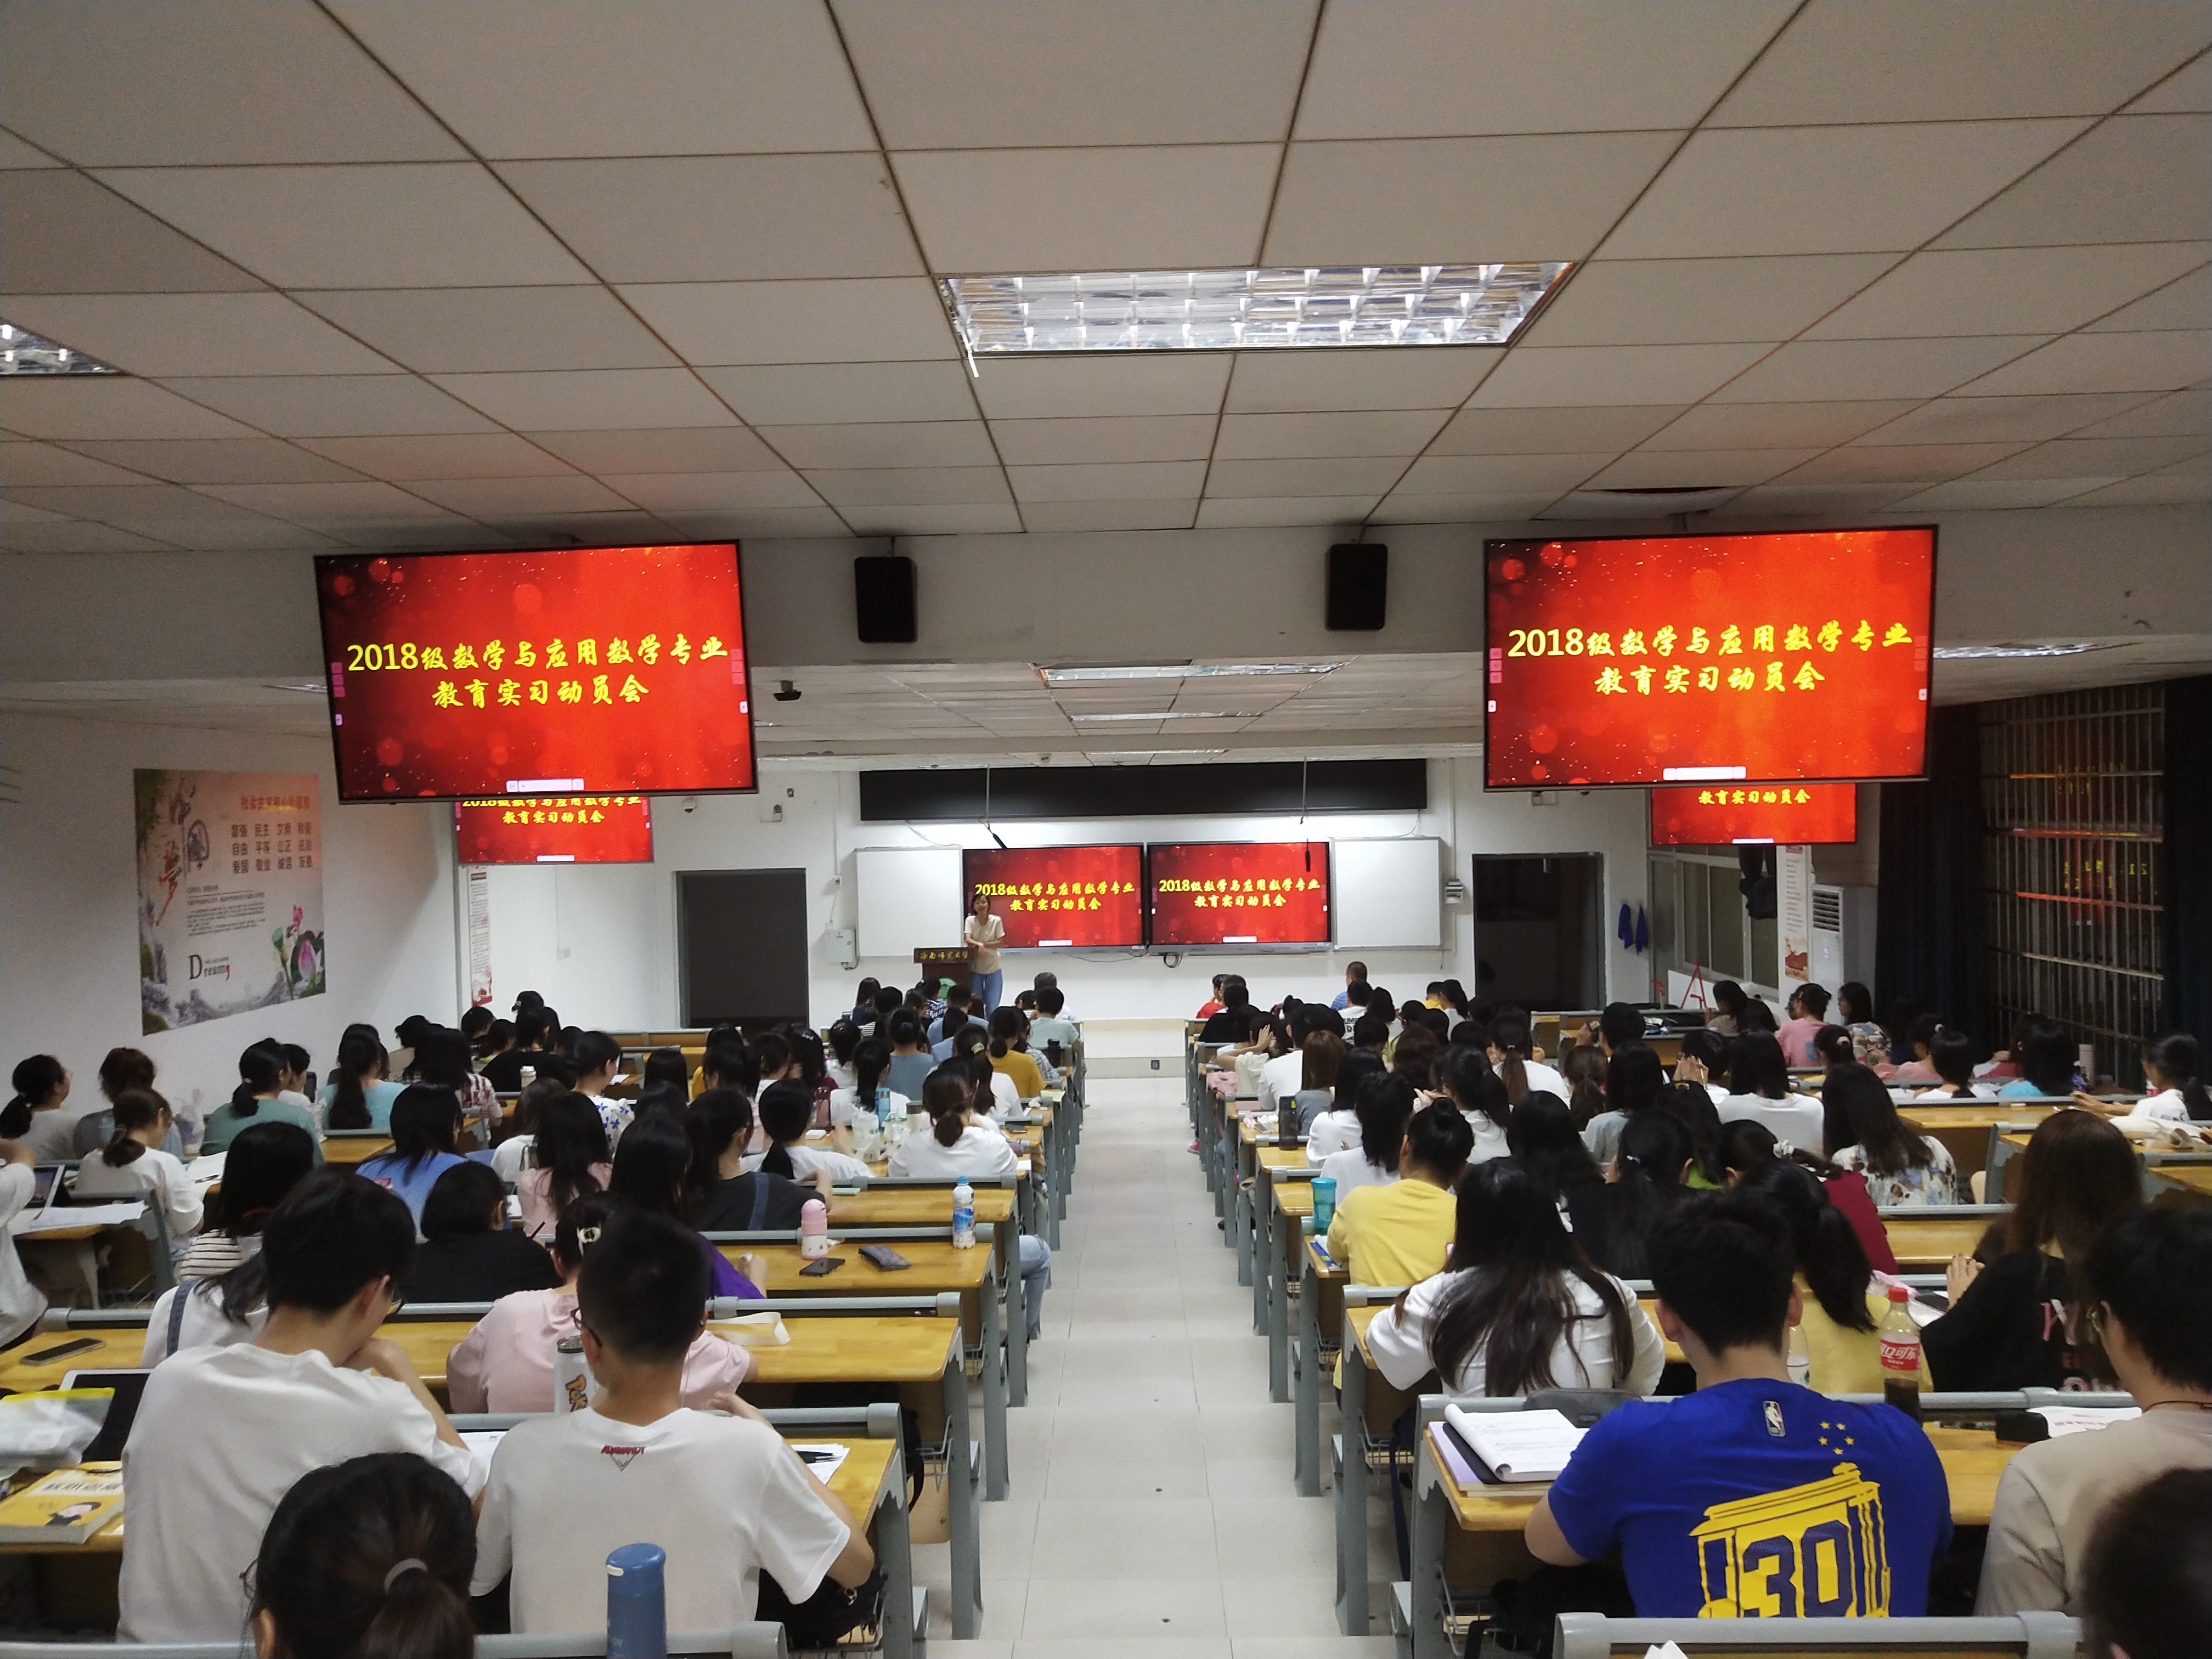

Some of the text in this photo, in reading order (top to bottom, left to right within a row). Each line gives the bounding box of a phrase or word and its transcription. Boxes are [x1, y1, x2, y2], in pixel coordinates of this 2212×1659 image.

[1508, 619, 1913, 657] 2018级数学与应用数学专业
[347, 633, 729, 671] 2018级数学与应用数学专业
[431, 674, 650, 709] 教育实习动员会
[1593, 661, 1826, 696] 教育实习动员会
[1697, 788, 1812, 805] 教育实习动员会
[501, 809, 606, 825] 教育实习动员会
[1158, 877, 1321, 893] 2018级数学与应用数学专业
[1009, 897, 1102, 912] 教育实习动员会
[1193, 893, 1287, 908] 教育实习动员会
[1743, 1520, 1854, 1618] 30
